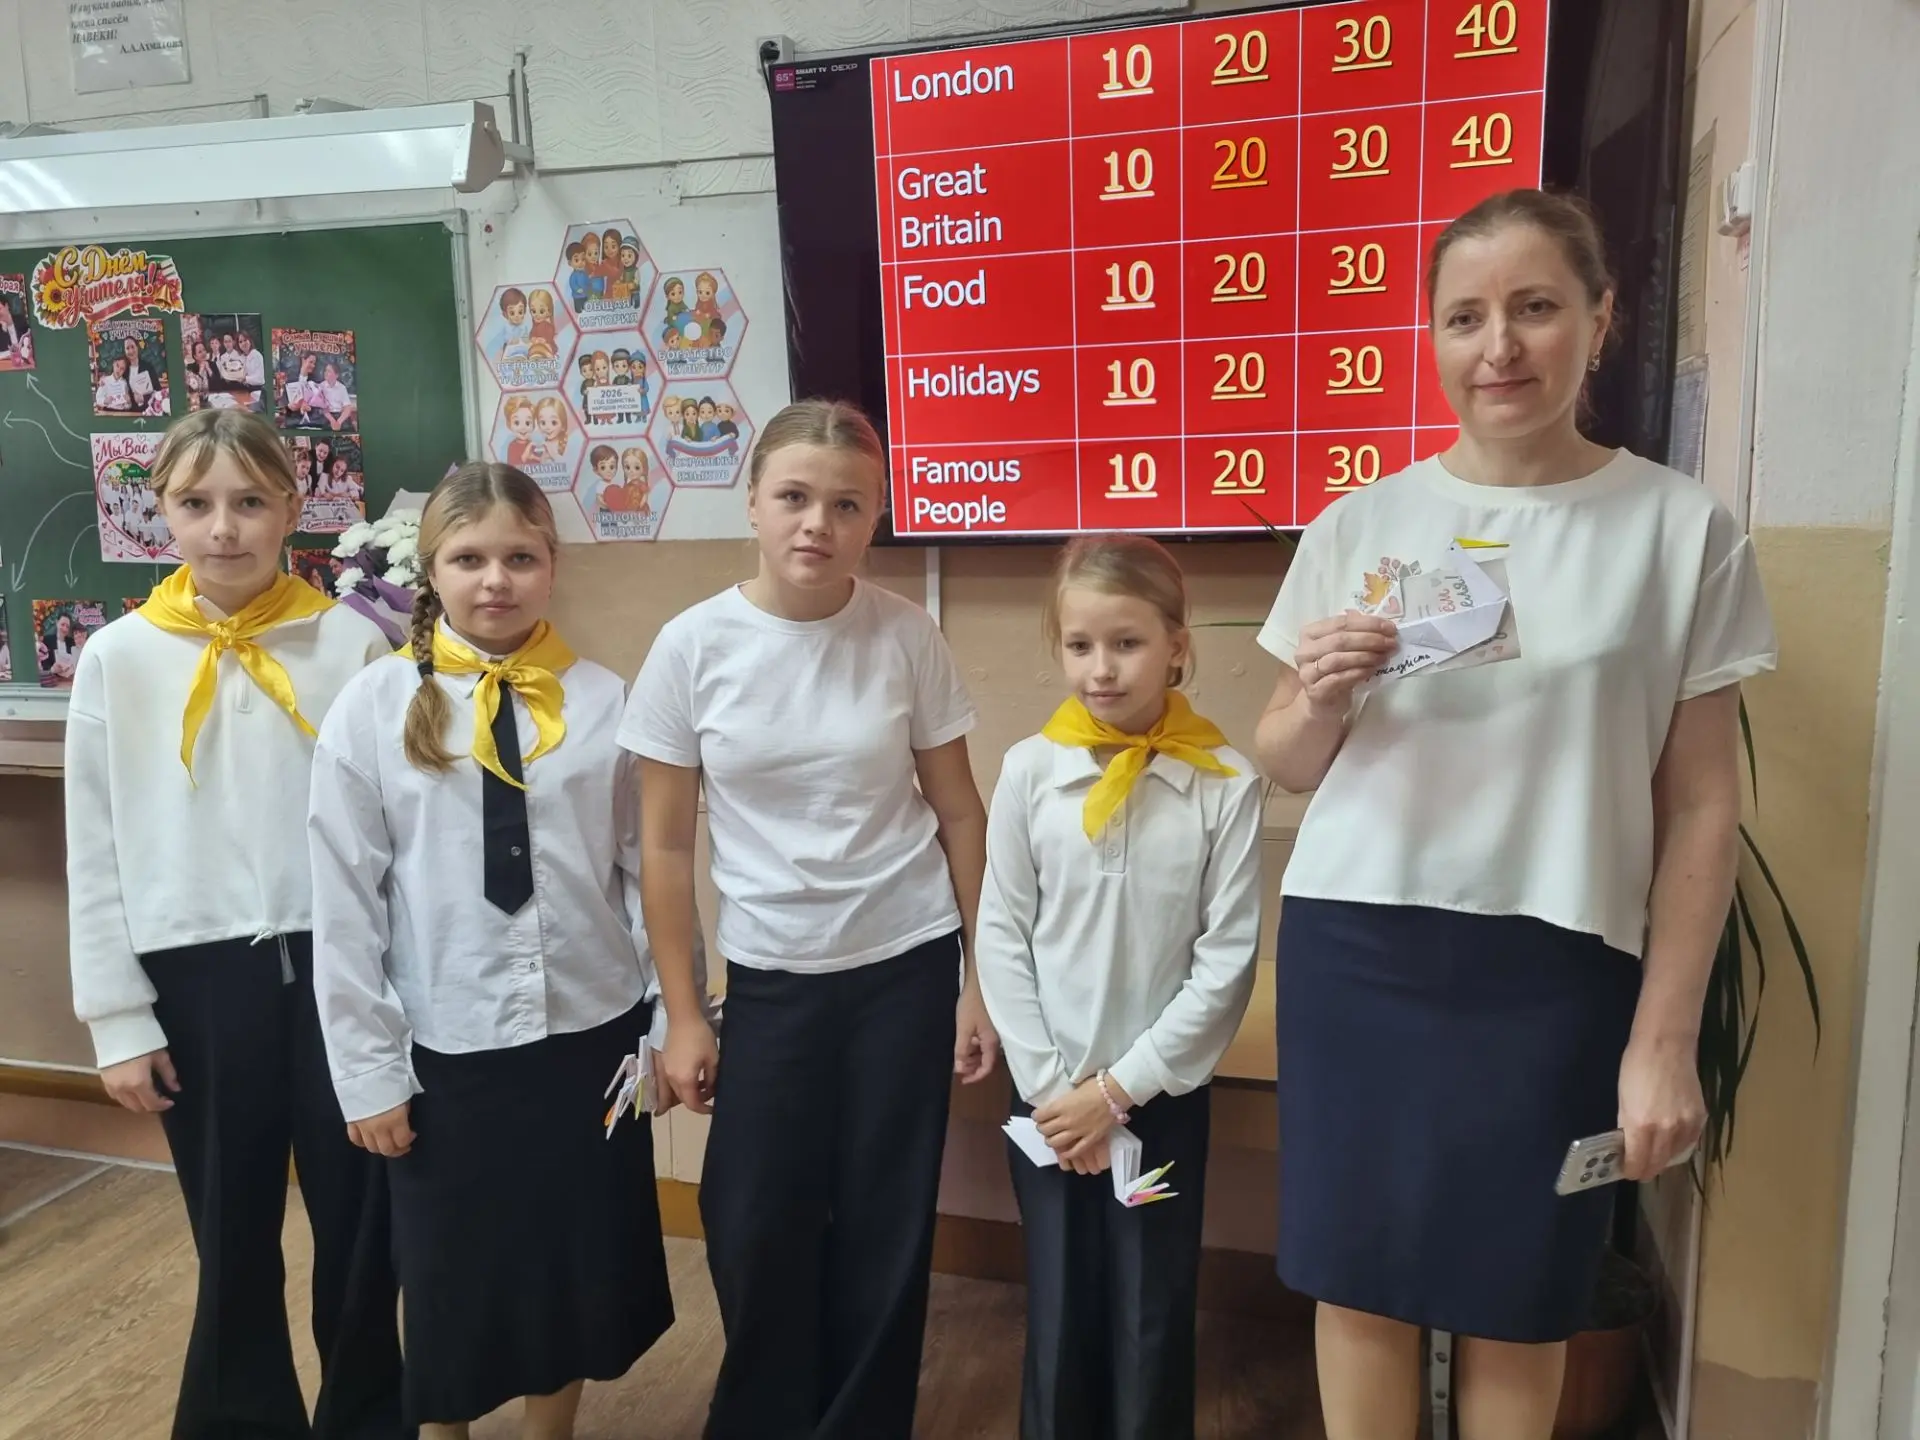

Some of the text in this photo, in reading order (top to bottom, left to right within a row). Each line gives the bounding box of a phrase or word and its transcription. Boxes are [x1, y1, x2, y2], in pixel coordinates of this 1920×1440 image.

[73, 29, 118, 44] НАВЕКИ!
[894, 0, 1517, 103] London 10 20 30 40
[898, 113, 1513, 200] Great 10 20 30 40
[901, 211, 1003, 248] Britain
[54, 245, 147, 288] С Днём
[904, 244, 1387, 310] Food 10 20 30
[584, 299, 631, 312] ОБЩАЯ
[580, 312, 639, 328] ИСТОРИЯ
[657, 346, 732, 362] БОГАТСТВО
[668, 361, 724, 376] КУЛЬТУР
[908, 346, 1384, 407] Holidays 10 20 30
[600, 389, 623, 398] 2026
[96, 440, 123, 463] Мы
[122, 437, 149, 456] Вас
[912, 444, 1381, 499] Famous 10 20 30
[592, 511, 646, 524] ЛЮБОВЬ
[914, 495, 1007, 530] People
[601, 524, 651, 538] РОДИНЕ
